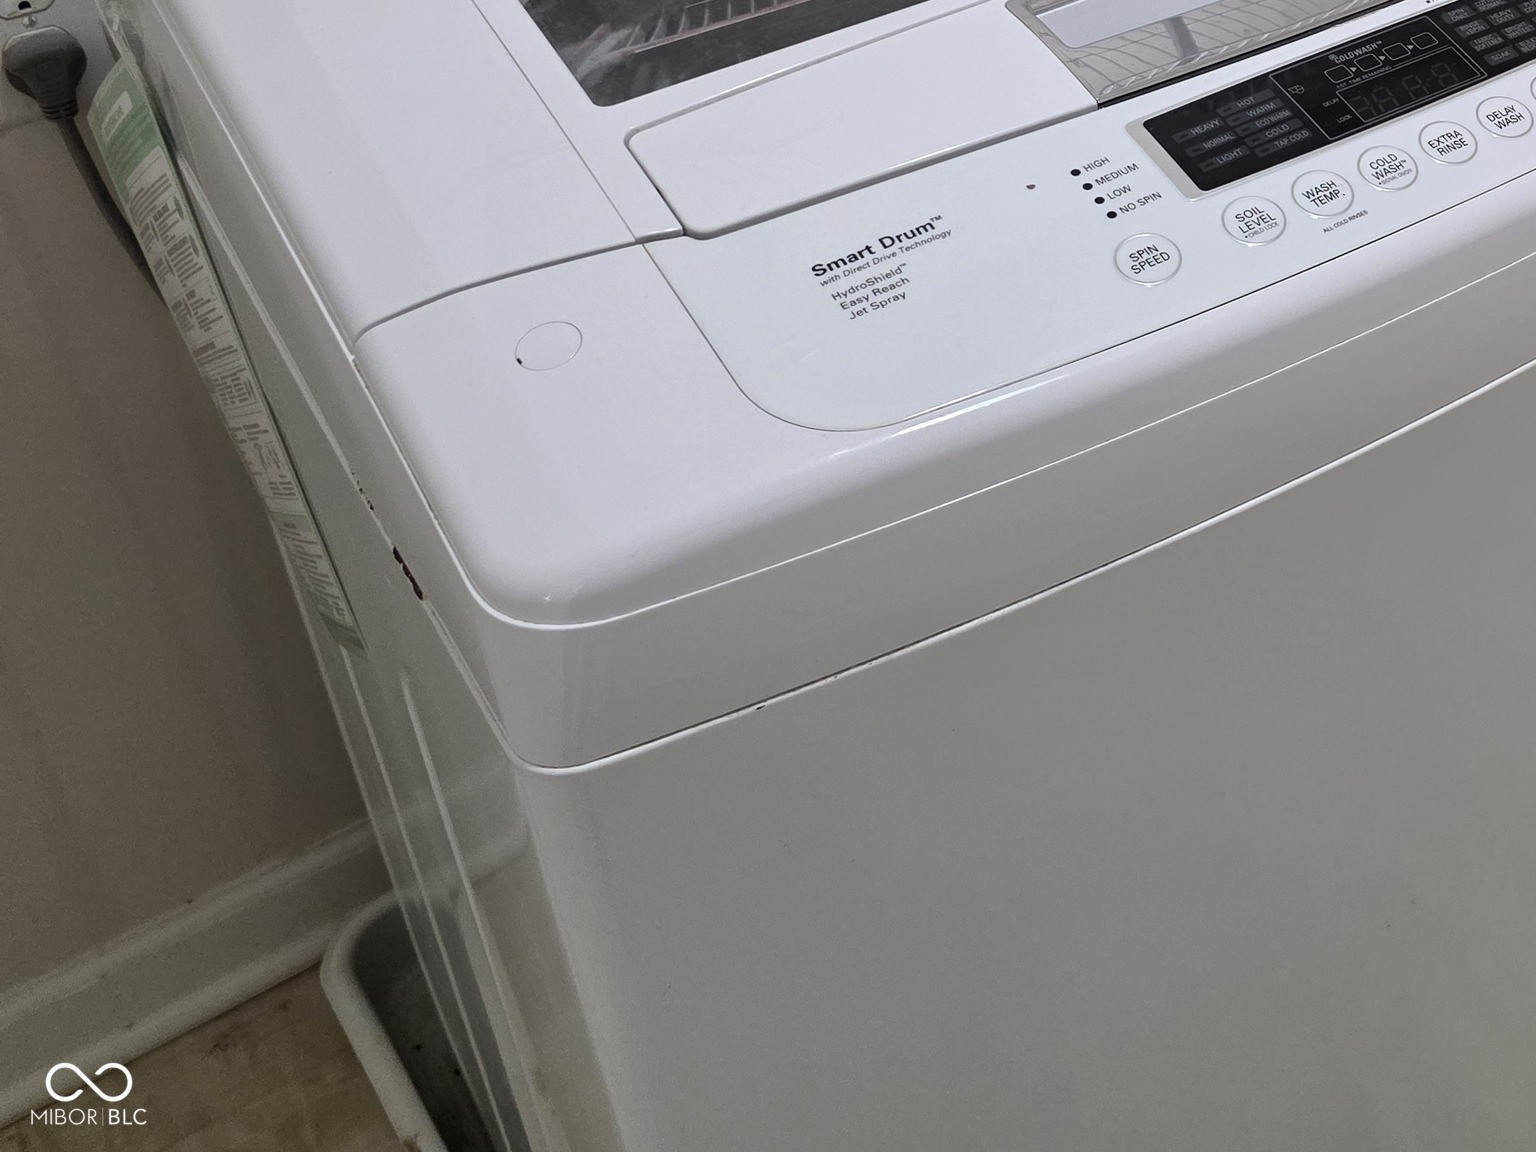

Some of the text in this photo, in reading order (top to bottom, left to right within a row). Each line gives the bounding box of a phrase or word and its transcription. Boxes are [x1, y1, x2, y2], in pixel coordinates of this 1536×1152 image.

[1237, 97, 1256, 108] HOT
[1246, 102, 1276, 118] WARM
[1322, 97, 1340, 108] DELAY
[1255, 110, 1292, 128] ECO WARM
[1336, 114, 1353, 124] LOCK
[1486, 104, 1517, 123] DELAY
[1494, 112, 1525, 130] WASH
[1191, 118, 1220, 136] HEAVY
[1265, 124, 1290, 138] COLD
[1203, 132, 1234, 150] NORMAL
[1274, 129, 1309, 148] TAP COLD
[1427, 130, 1463, 150] EXTRA
[1436, 138, 1468, 157] RINSE
[1083, 156, 1110, 172] HIGH
[1216, 148, 1243, 164] LIGHT
[1369, 153, 1398, 171] COLD
[1094, 163, 1139, 186] MEDIUM
[1106, 184, 1132, 200] LOW
[1302, 180, 1337, 200] WASH
[1119, 191, 1163, 215] NO SPIN
[1235, 205, 1265, 223] SOIL
[1238, 212, 1277, 234] LEVEL
[1322, 209, 1369, 234] ALL COLD RINSES
[1248, 221, 1280, 239] CHILD LOCK
[811, 244, 876, 278] Smart
[820, 229, 952, 287] with Direct Drive Technology
[1129, 244, 1160, 263] SPIN
[1131, 251, 1171, 275] SPEED
[840, 276, 910, 311] Easy Reach
[849, 291, 907, 320] Jet Spray
